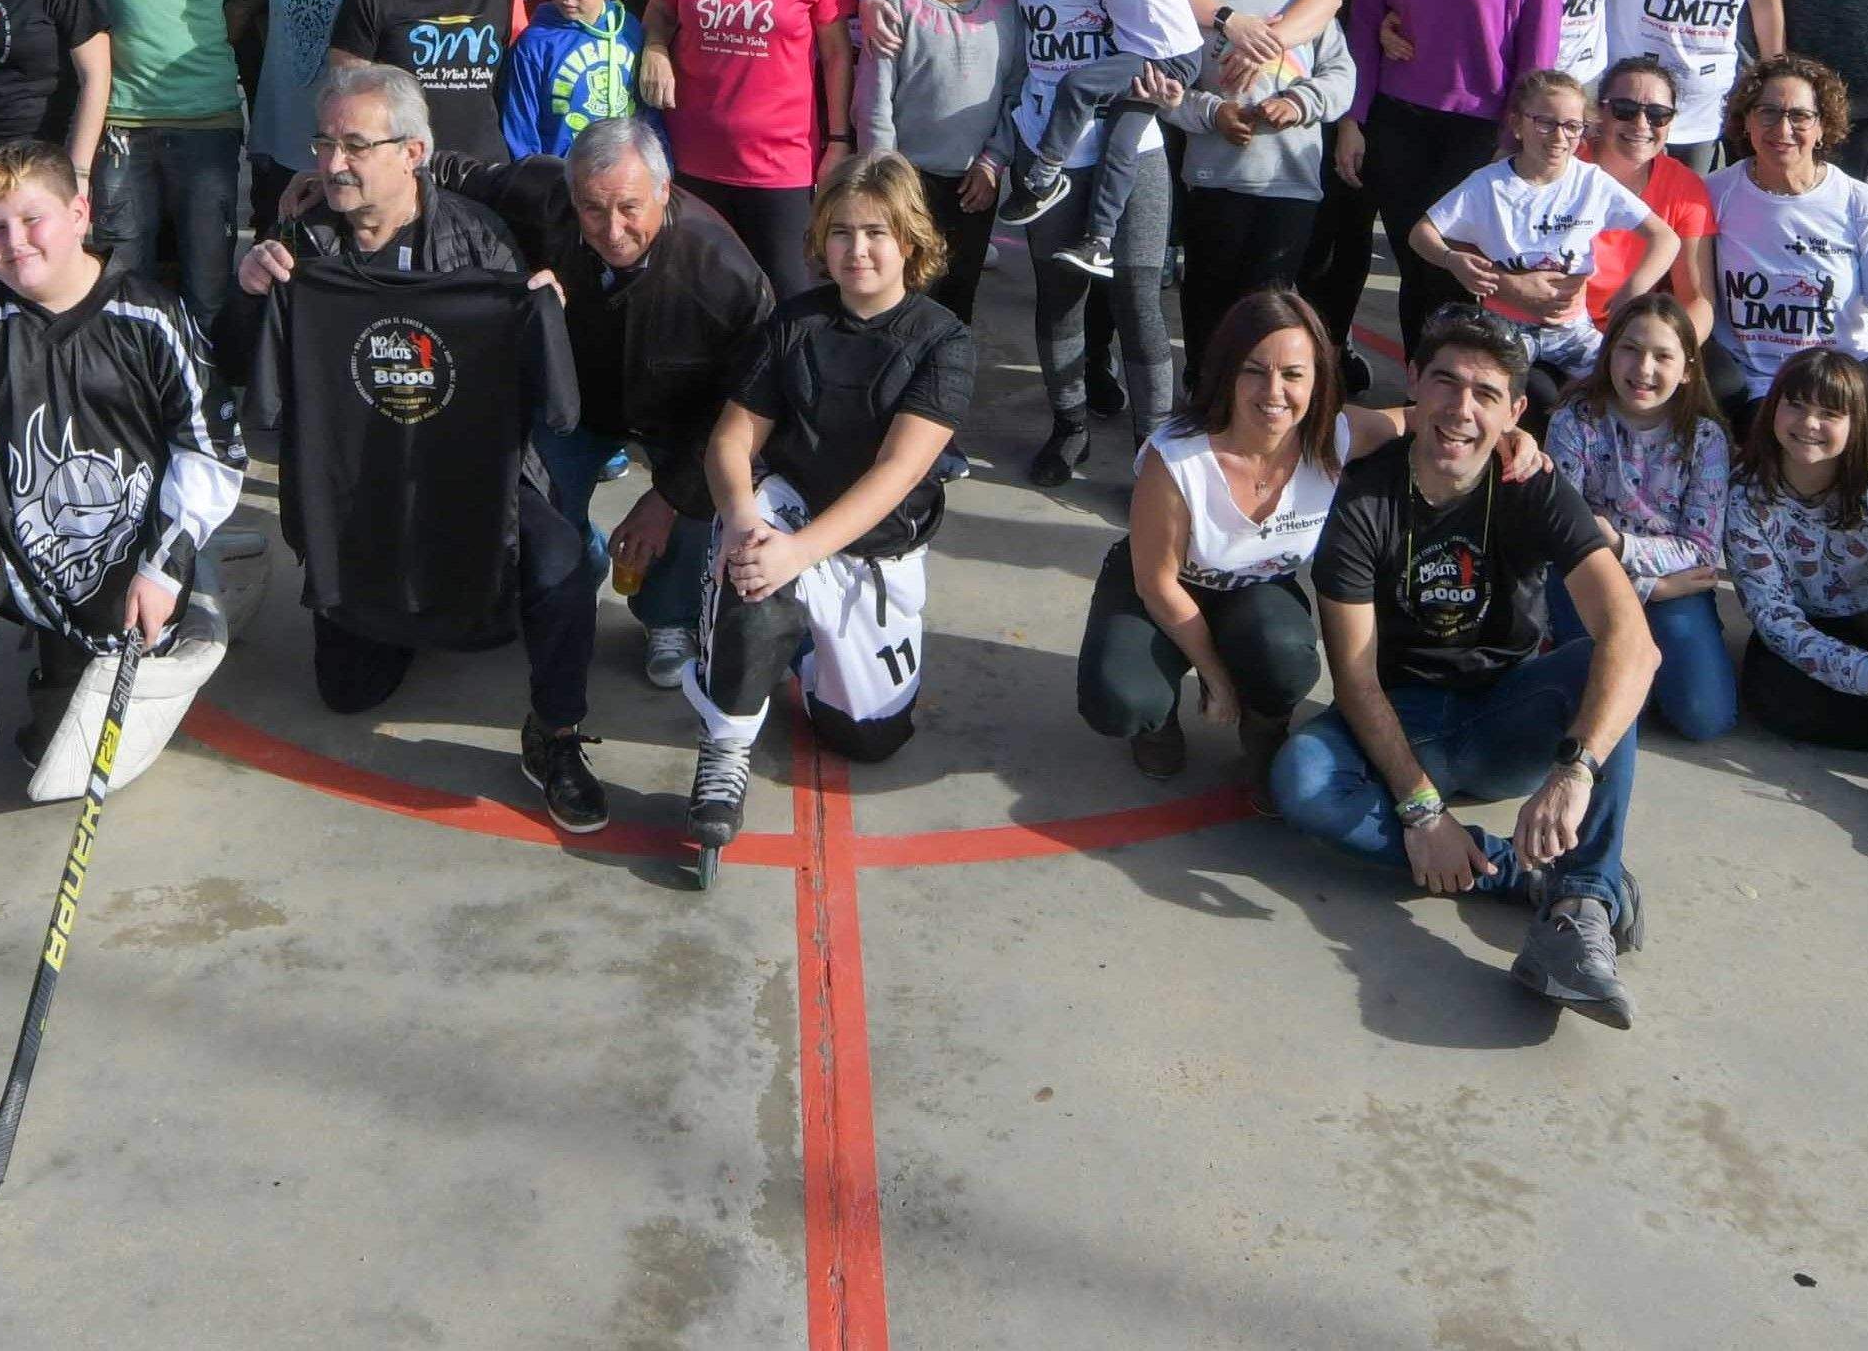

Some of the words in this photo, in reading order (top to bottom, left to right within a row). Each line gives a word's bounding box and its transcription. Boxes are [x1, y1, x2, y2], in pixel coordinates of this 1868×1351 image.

[416, 67, 438, 80] Soul
[441, 67, 468, 80] Mind
[471, 67, 493, 83] Body
[1725, 270, 1768, 300] NO
[1728, 297, 1835, 336] LIMITS
[371, 336, 388, 347] NO
[372, 347, 412, 360] LIMITS
[374, 370, 435, 385] 8000
[1419, 564, 1459, 583] LIMITS
[876, 637, 916, 686] 11
